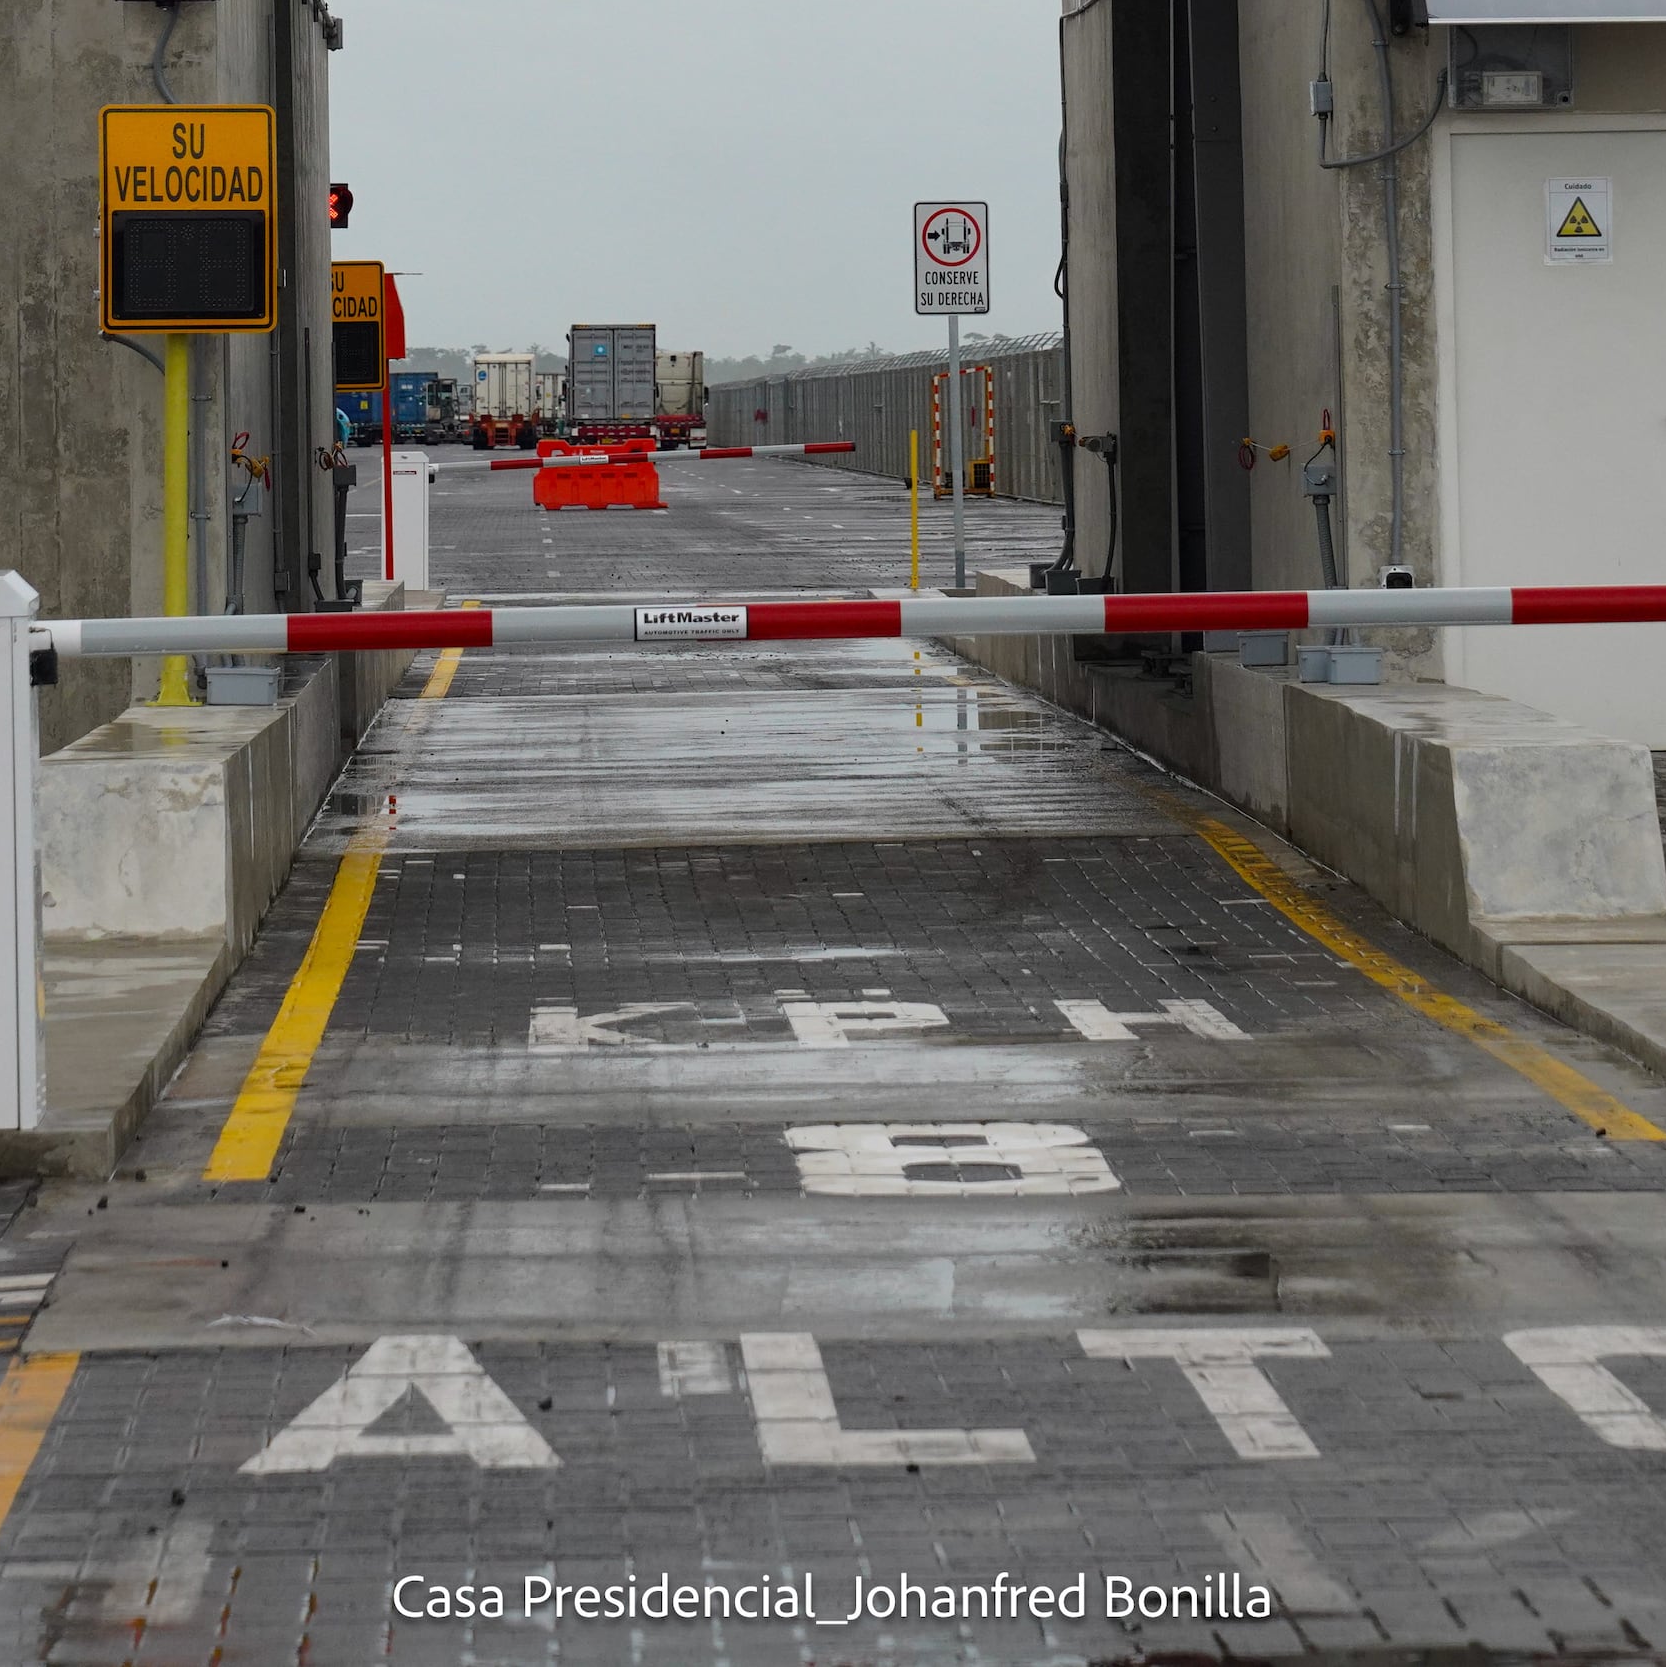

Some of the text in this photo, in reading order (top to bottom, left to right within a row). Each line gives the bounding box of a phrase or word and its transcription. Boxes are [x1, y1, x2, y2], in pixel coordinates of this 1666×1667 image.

[172, 122, 205, 159] SU
[114, 165, 263, 203] VELOCIDAD
[331, 271, 344, 292] U
[925, 271, 979, 285] CONSERVE
[921, 291, 984, 306] SU DERECHA
[644, 612, 739, 624] LiftMaster
